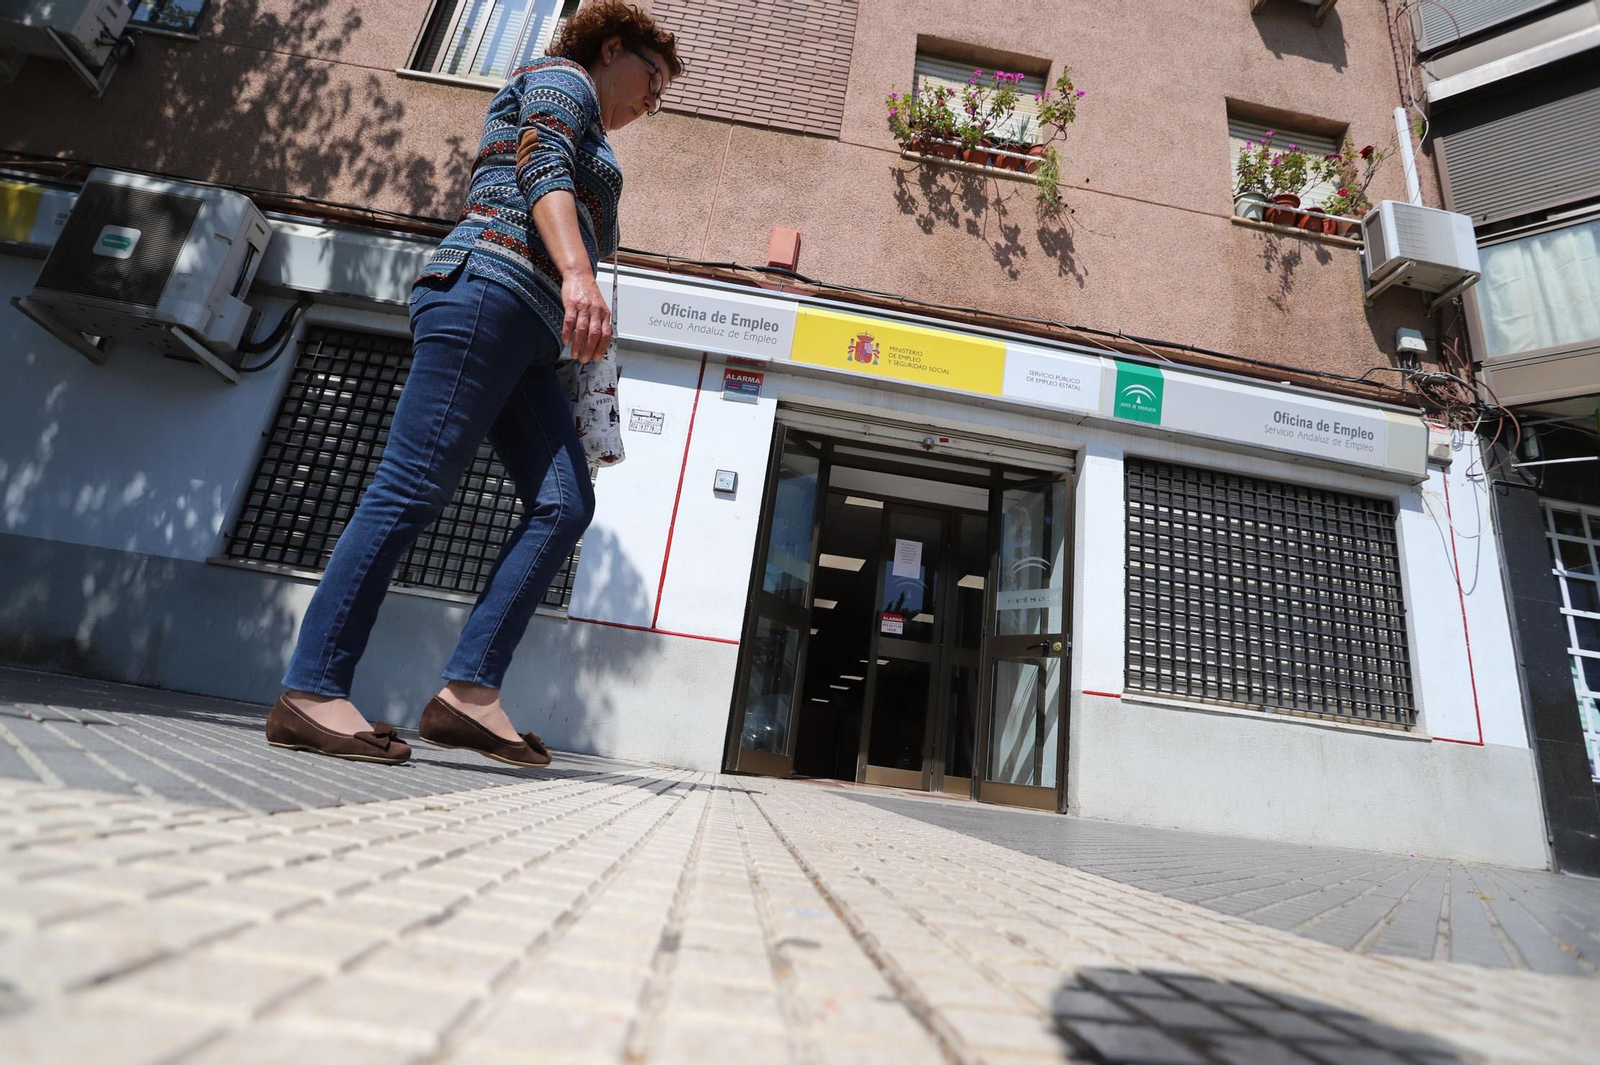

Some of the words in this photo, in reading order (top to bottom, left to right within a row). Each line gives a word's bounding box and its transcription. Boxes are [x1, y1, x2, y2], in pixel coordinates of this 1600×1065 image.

[661, 302, 707, 321] Oficina
[711, 310, 727, 324] de
[731, 313, 779, 332] Empleo
[648, 316, 684, 330] Servicio
[687, 322, 725, 337] Andaluz
[728, 329, 740, 339] de
[743, 331, 778, 345] Empleo
[889, 346, 923, 357] MINISTERIO
[898, 354, 921, 363] EMPLEO
[893, 360, 927, 371] SEGURIDAD
[929, 366, 950, 375] SOCIAL
[1029, 370, 1054, 379] SERVICIO
[725, 373, 761, 384] ALARMA
[1036, 377, 1058, 387] EMPLEO
[1059, 382, 1081, 391] ESTATAL
[1273, 411, 1313, 429] Oficina
[1316, 419, 1330, 432] de
[1333, 422, 1374, 441] Empleo
[1264, 424, 1294, 438] Servicio
[1297, 431, 1329, 444] Andaluz
[1332, 438, 1342, 447] de
[1345, 439, 1374, 453] Empleo
